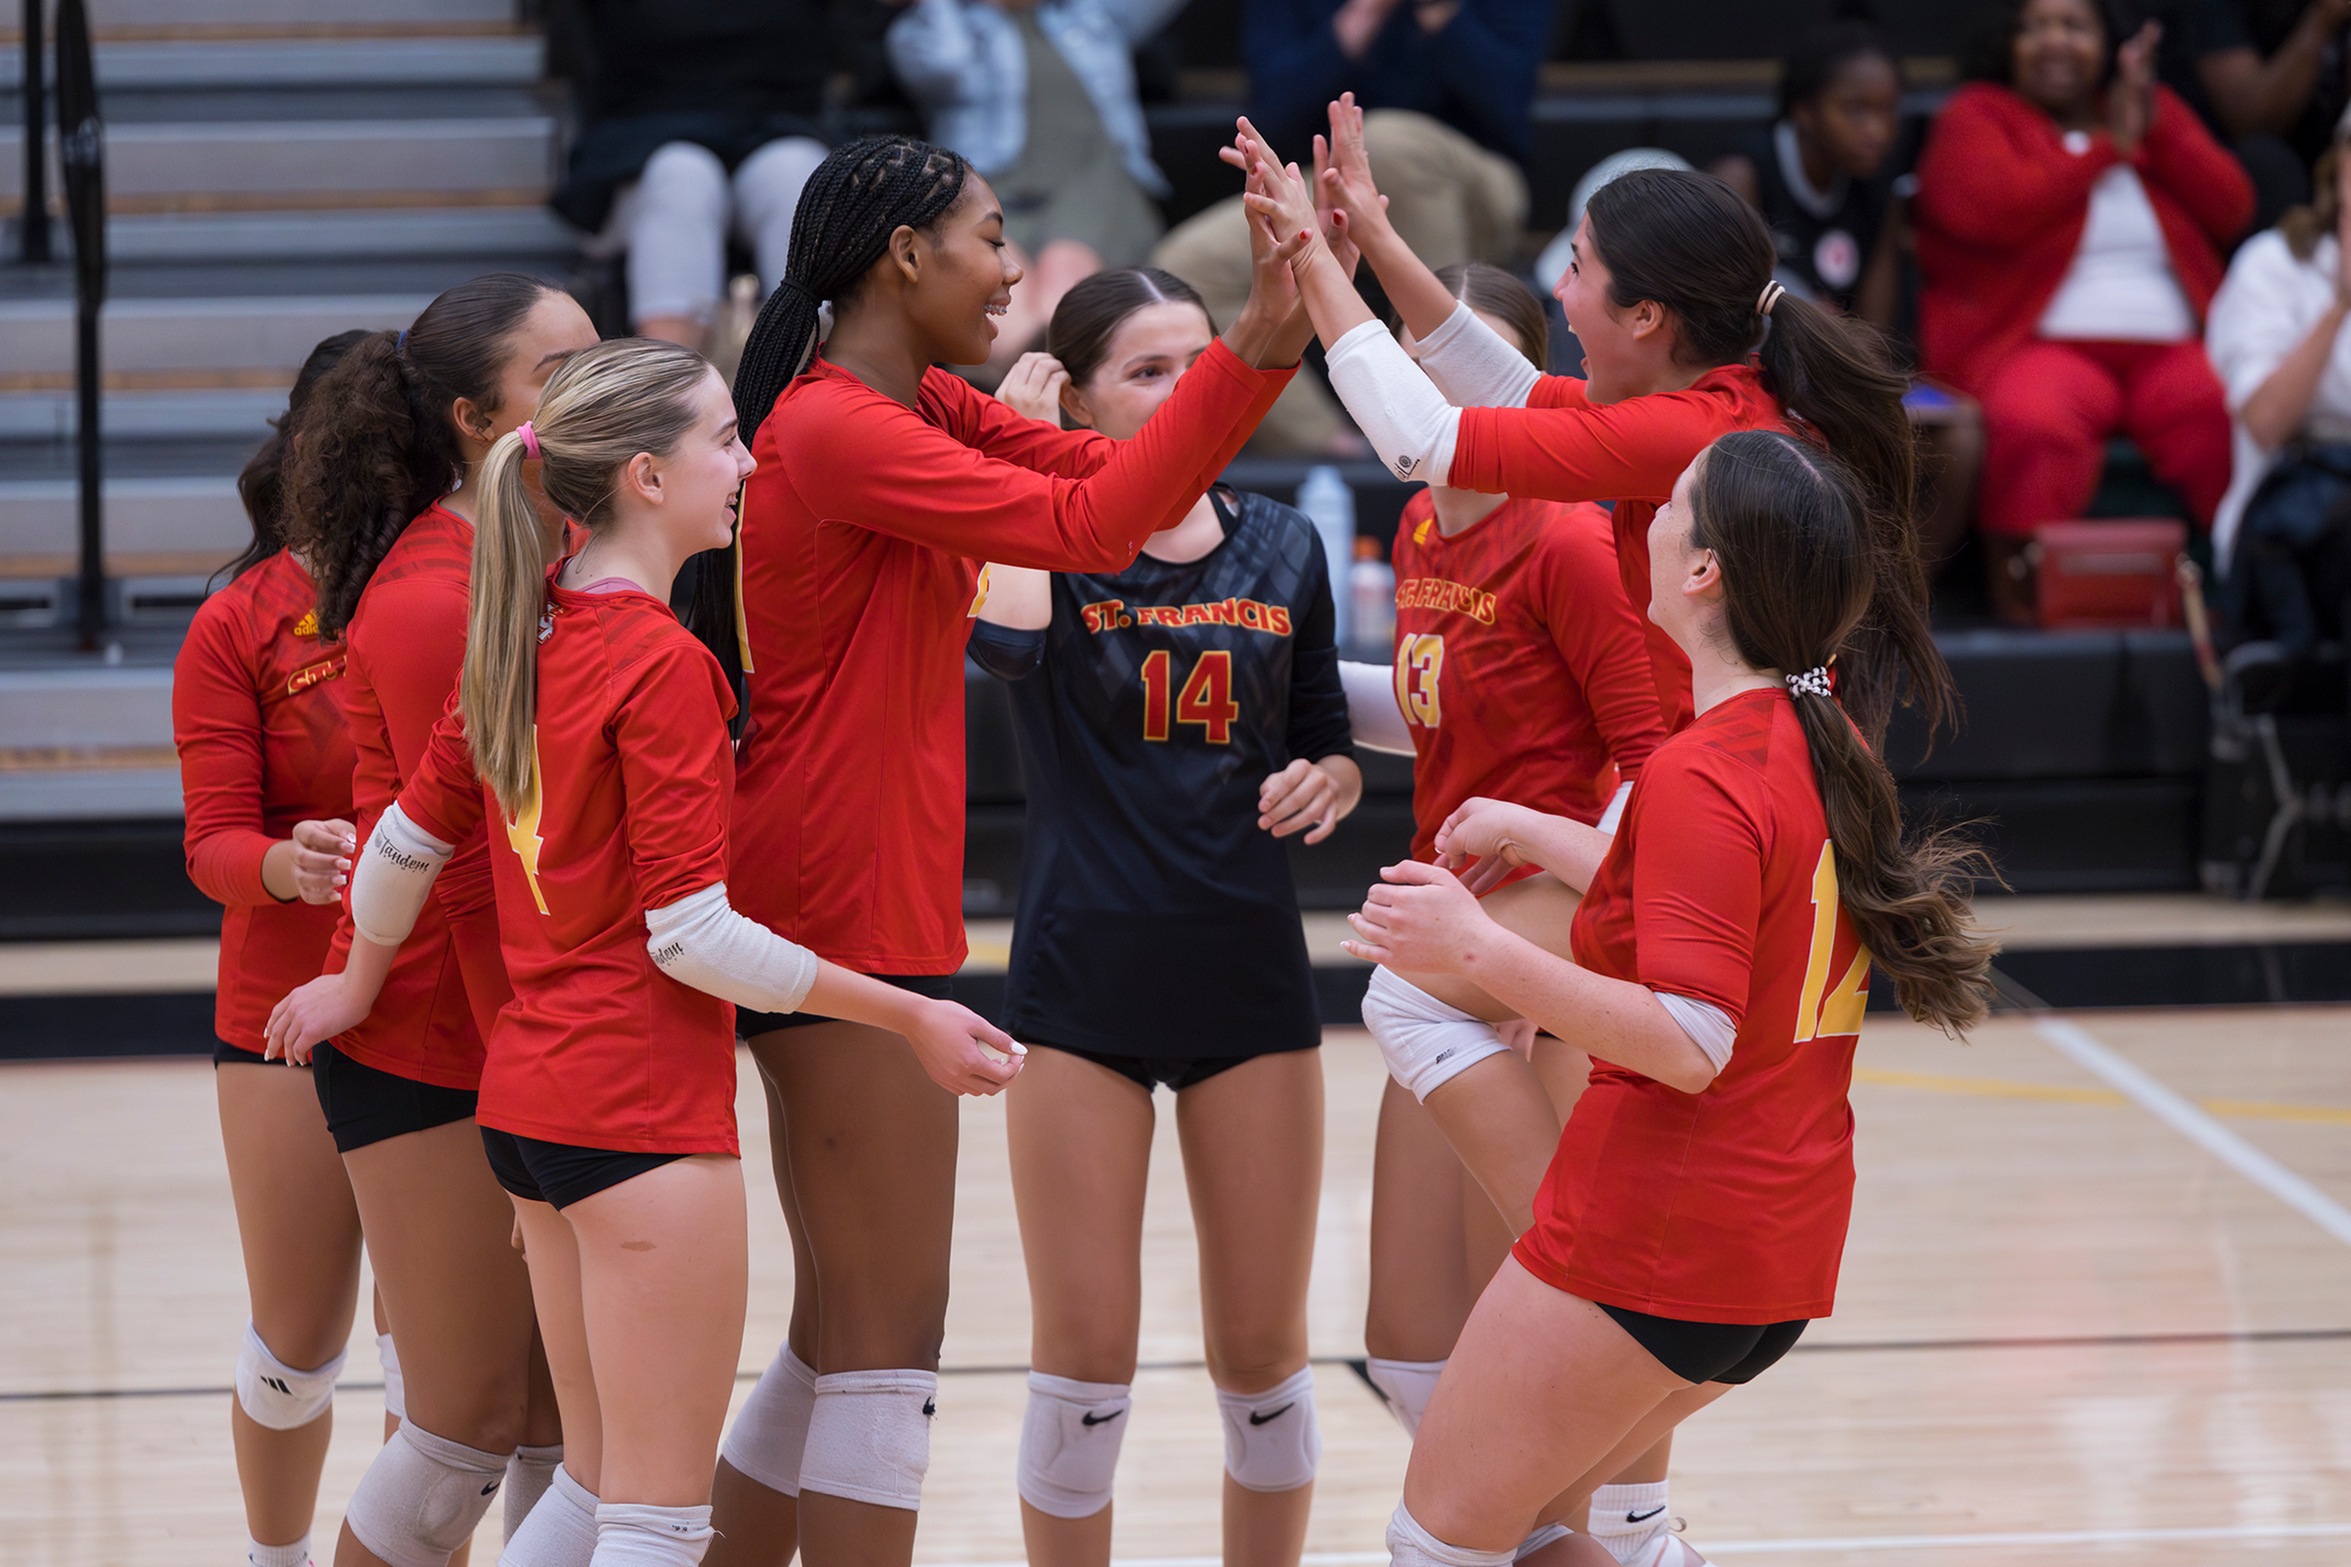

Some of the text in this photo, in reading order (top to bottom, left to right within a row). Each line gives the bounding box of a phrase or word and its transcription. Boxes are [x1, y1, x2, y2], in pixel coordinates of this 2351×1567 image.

[1081, 597, 1293, 637] ST. FRANCIS
[1141, 650, 1239, 744] 14
[1396, 632, 1445, 728] 13
[379, 825, 430, 874] Tandem
